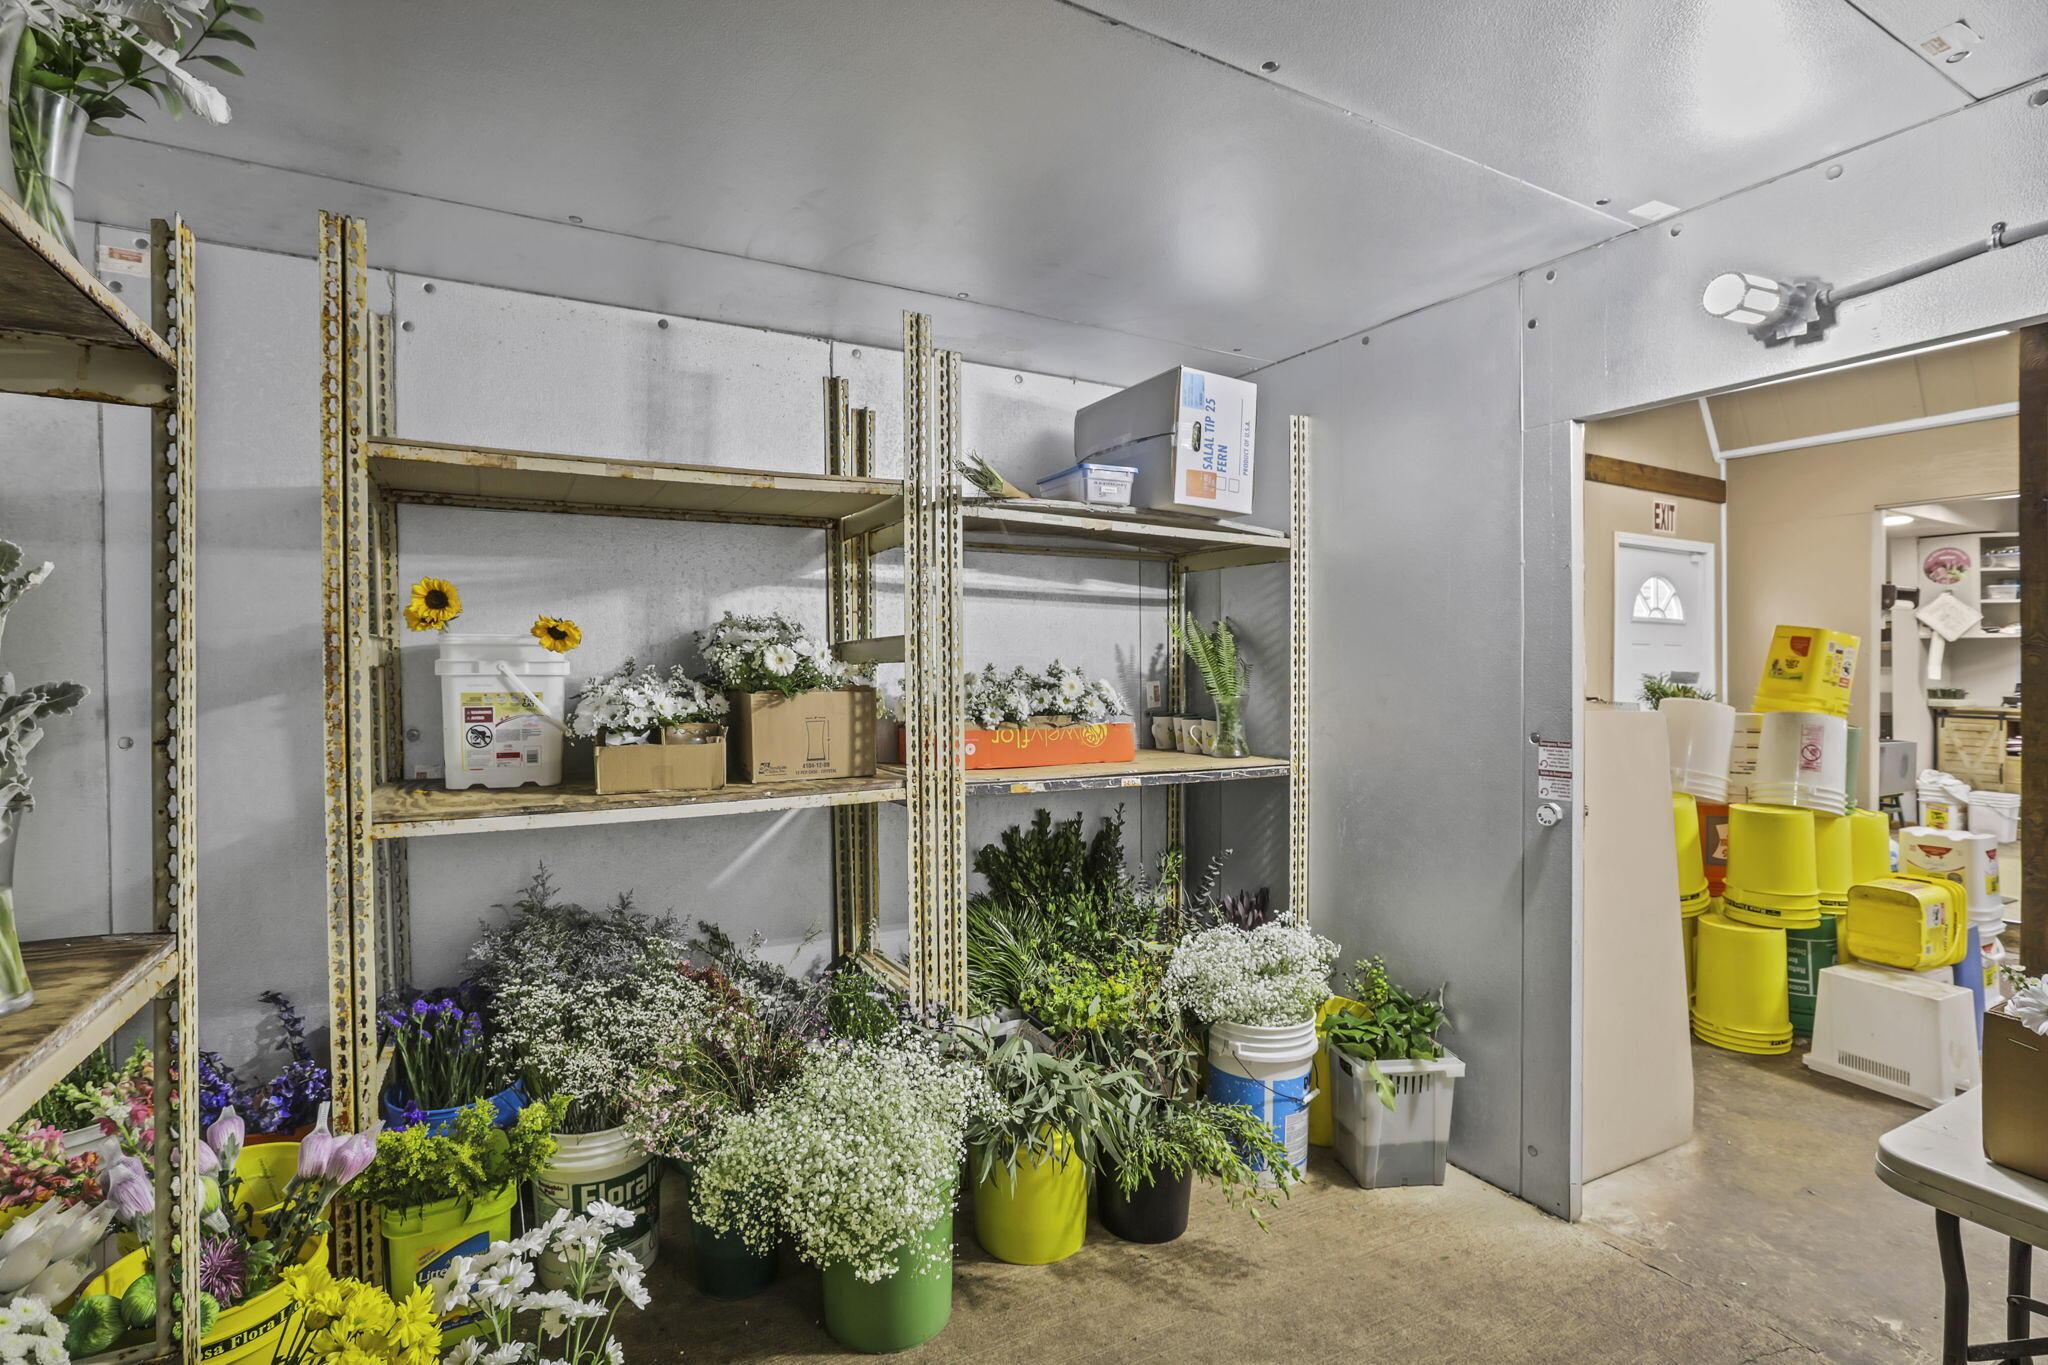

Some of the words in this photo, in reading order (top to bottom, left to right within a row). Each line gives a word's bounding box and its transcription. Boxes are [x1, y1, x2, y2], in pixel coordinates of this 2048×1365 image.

[1205, 398, 1216, 413] 25
[1204, 416, 1215, 432] TIP
[1202, 437, 1214, 470] SALAL
[1216, 444, 1228, 473] FERN
[1654, 502, 1675, 531] EXIT
[581, 1159, 656, 1212] Florali
[201, 1345, 225, 1360] sa
[230, 1319, 275, 1349] Flora
